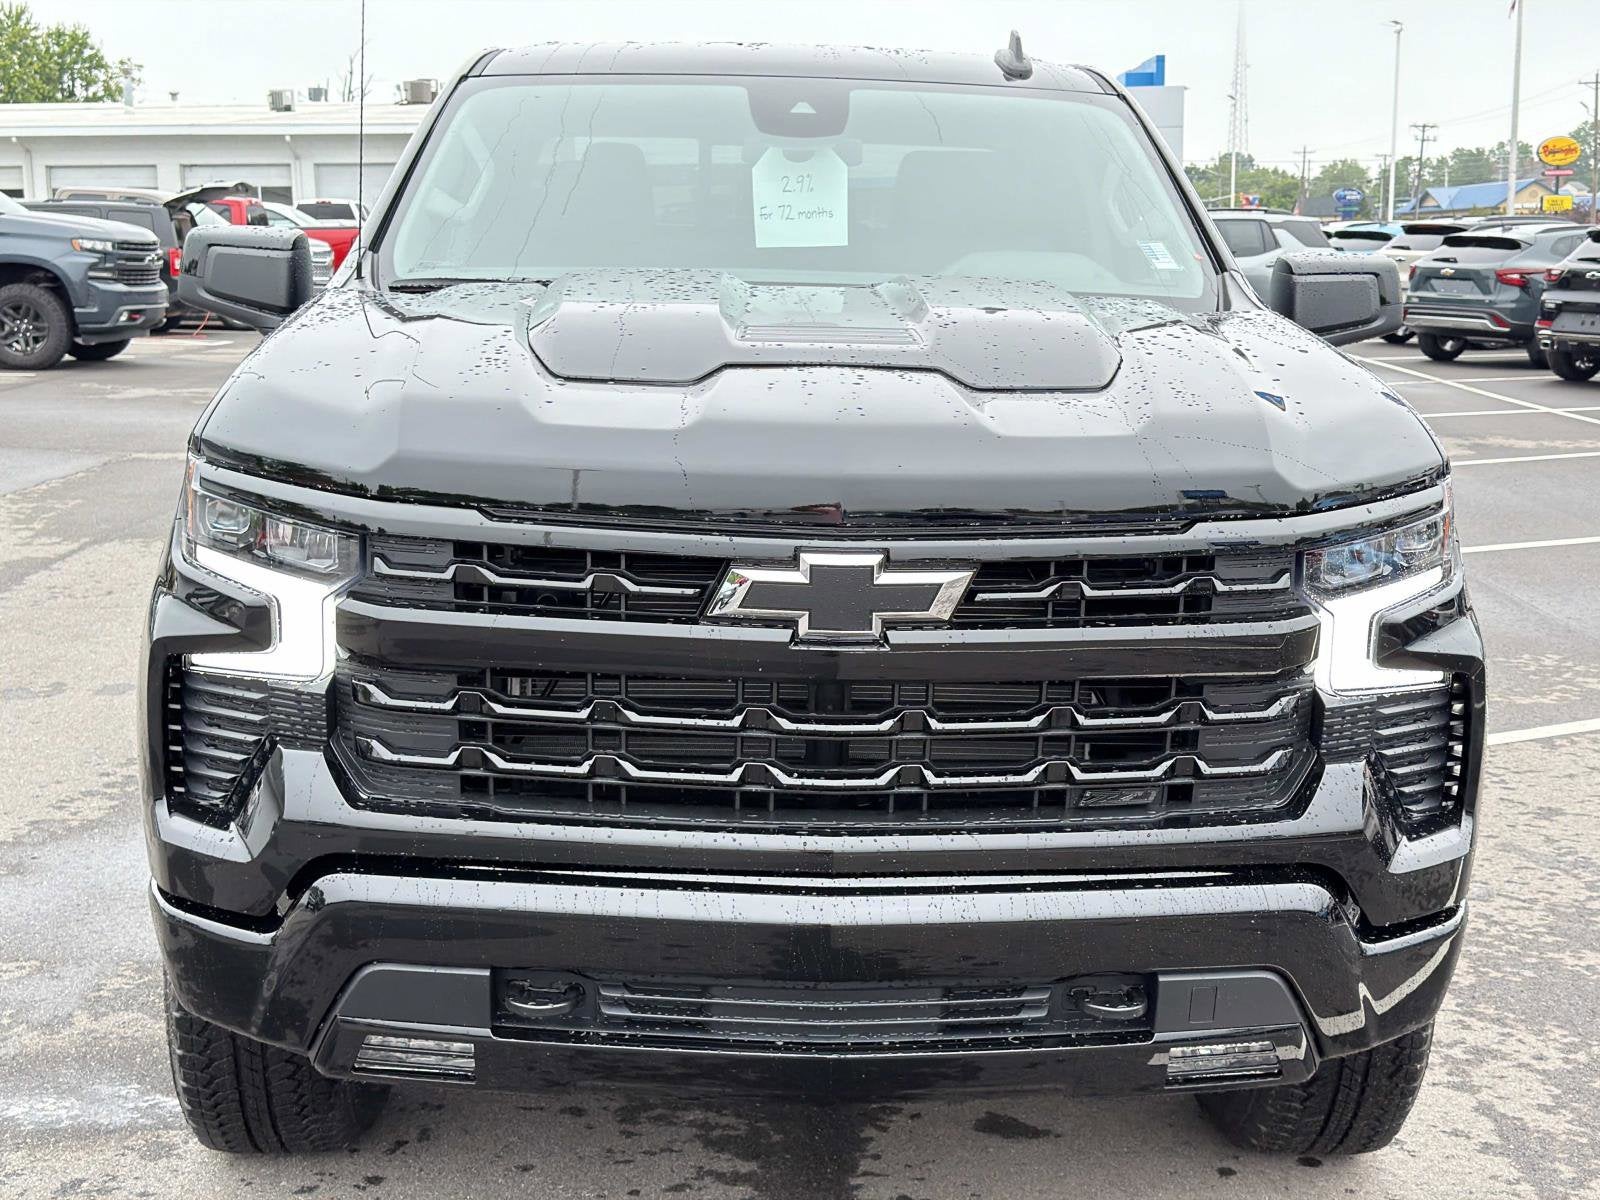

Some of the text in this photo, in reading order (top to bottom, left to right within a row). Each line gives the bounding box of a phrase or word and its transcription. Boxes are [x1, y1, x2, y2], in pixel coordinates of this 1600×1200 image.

[781, 173, 815, 193] 2.9%
[760, 204, 834, 221] For 72 months
